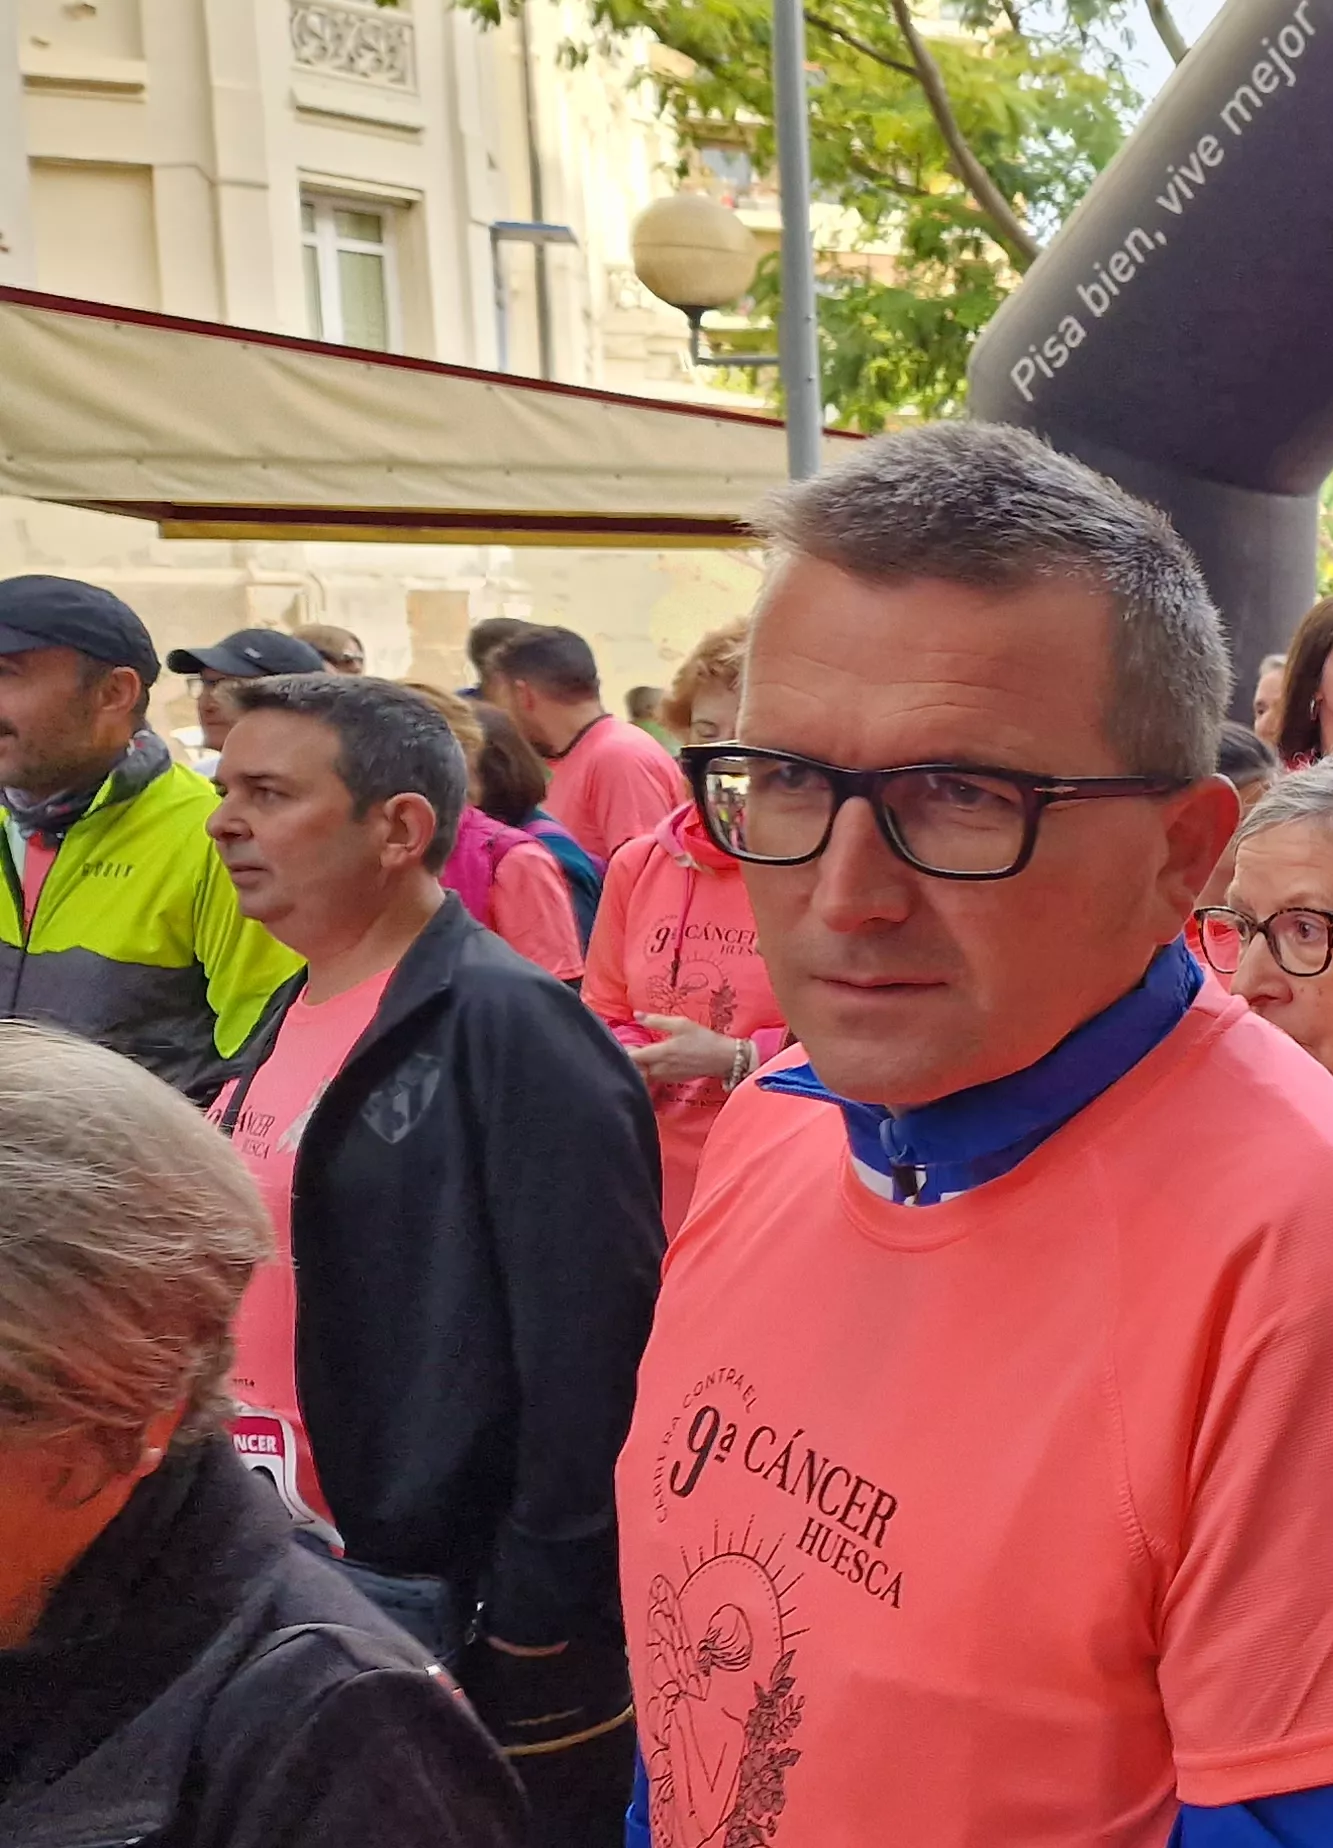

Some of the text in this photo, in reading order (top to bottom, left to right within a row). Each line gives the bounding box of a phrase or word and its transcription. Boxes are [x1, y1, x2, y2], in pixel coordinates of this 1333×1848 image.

[1009, 0, 1319, 403] Pisa bien, vive mejor
[232, 1433, 278, 1454] NCER
[669, 1405, 899, 1549] 9ª CÁNCER
[796, 1516, 906, 1609] HUESCA
